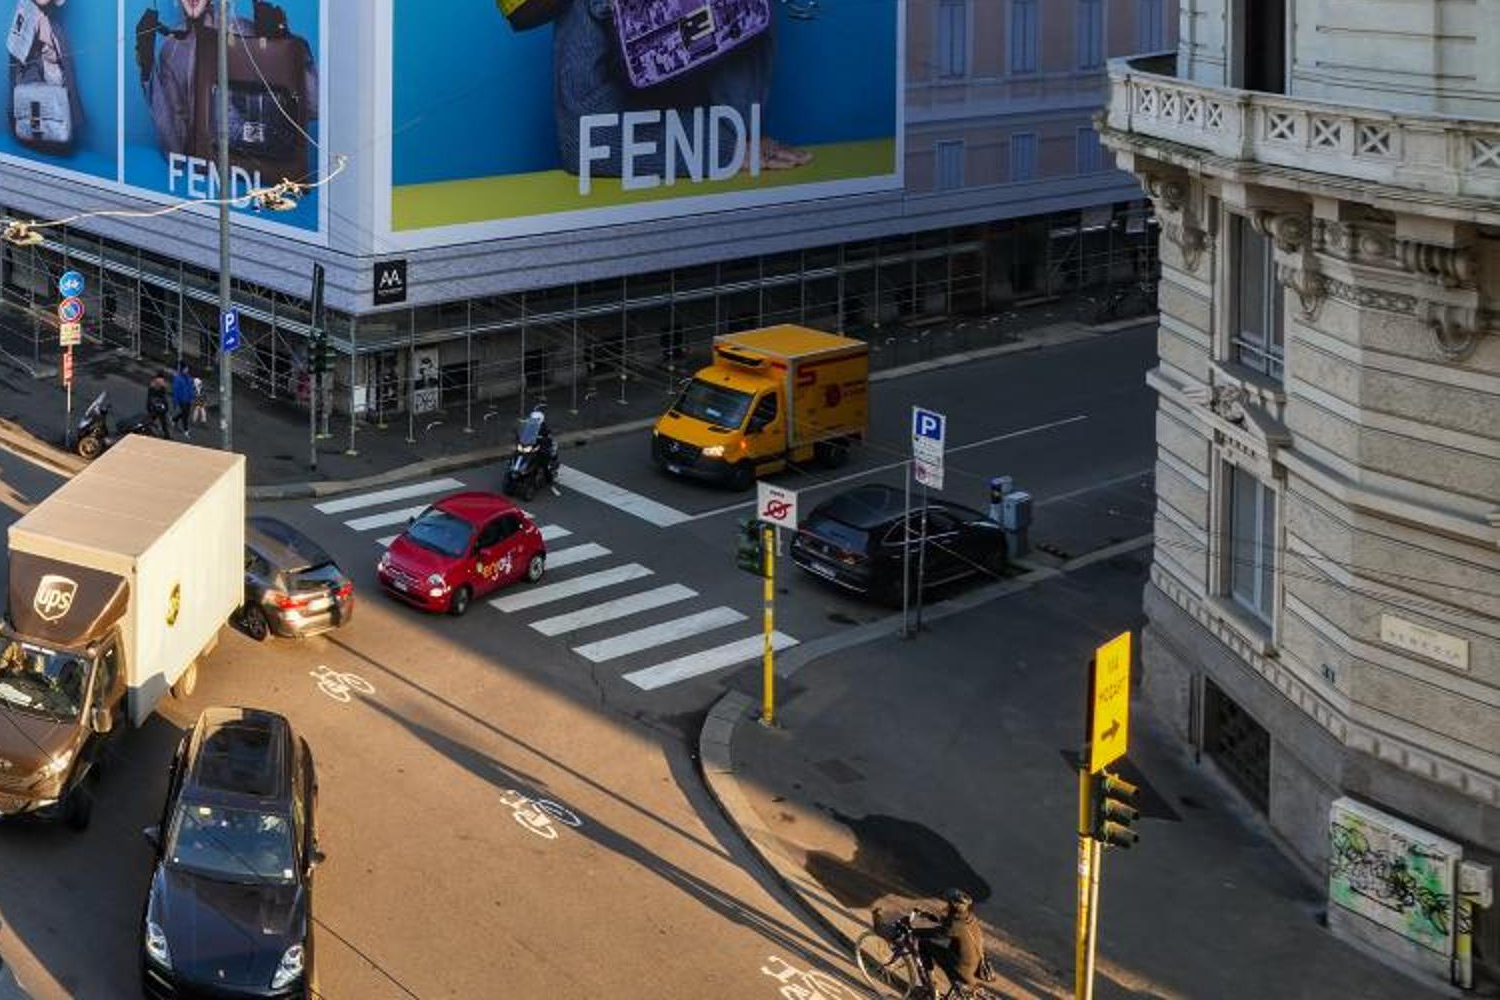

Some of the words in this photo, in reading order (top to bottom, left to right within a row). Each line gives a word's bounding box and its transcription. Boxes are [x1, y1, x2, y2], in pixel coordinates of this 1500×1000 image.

[580, 104, 761, 195] FENDI
[225, 313, 235, 333] P
[921, 415, 938, 435] P
[38, 590, 71, 613] ups
